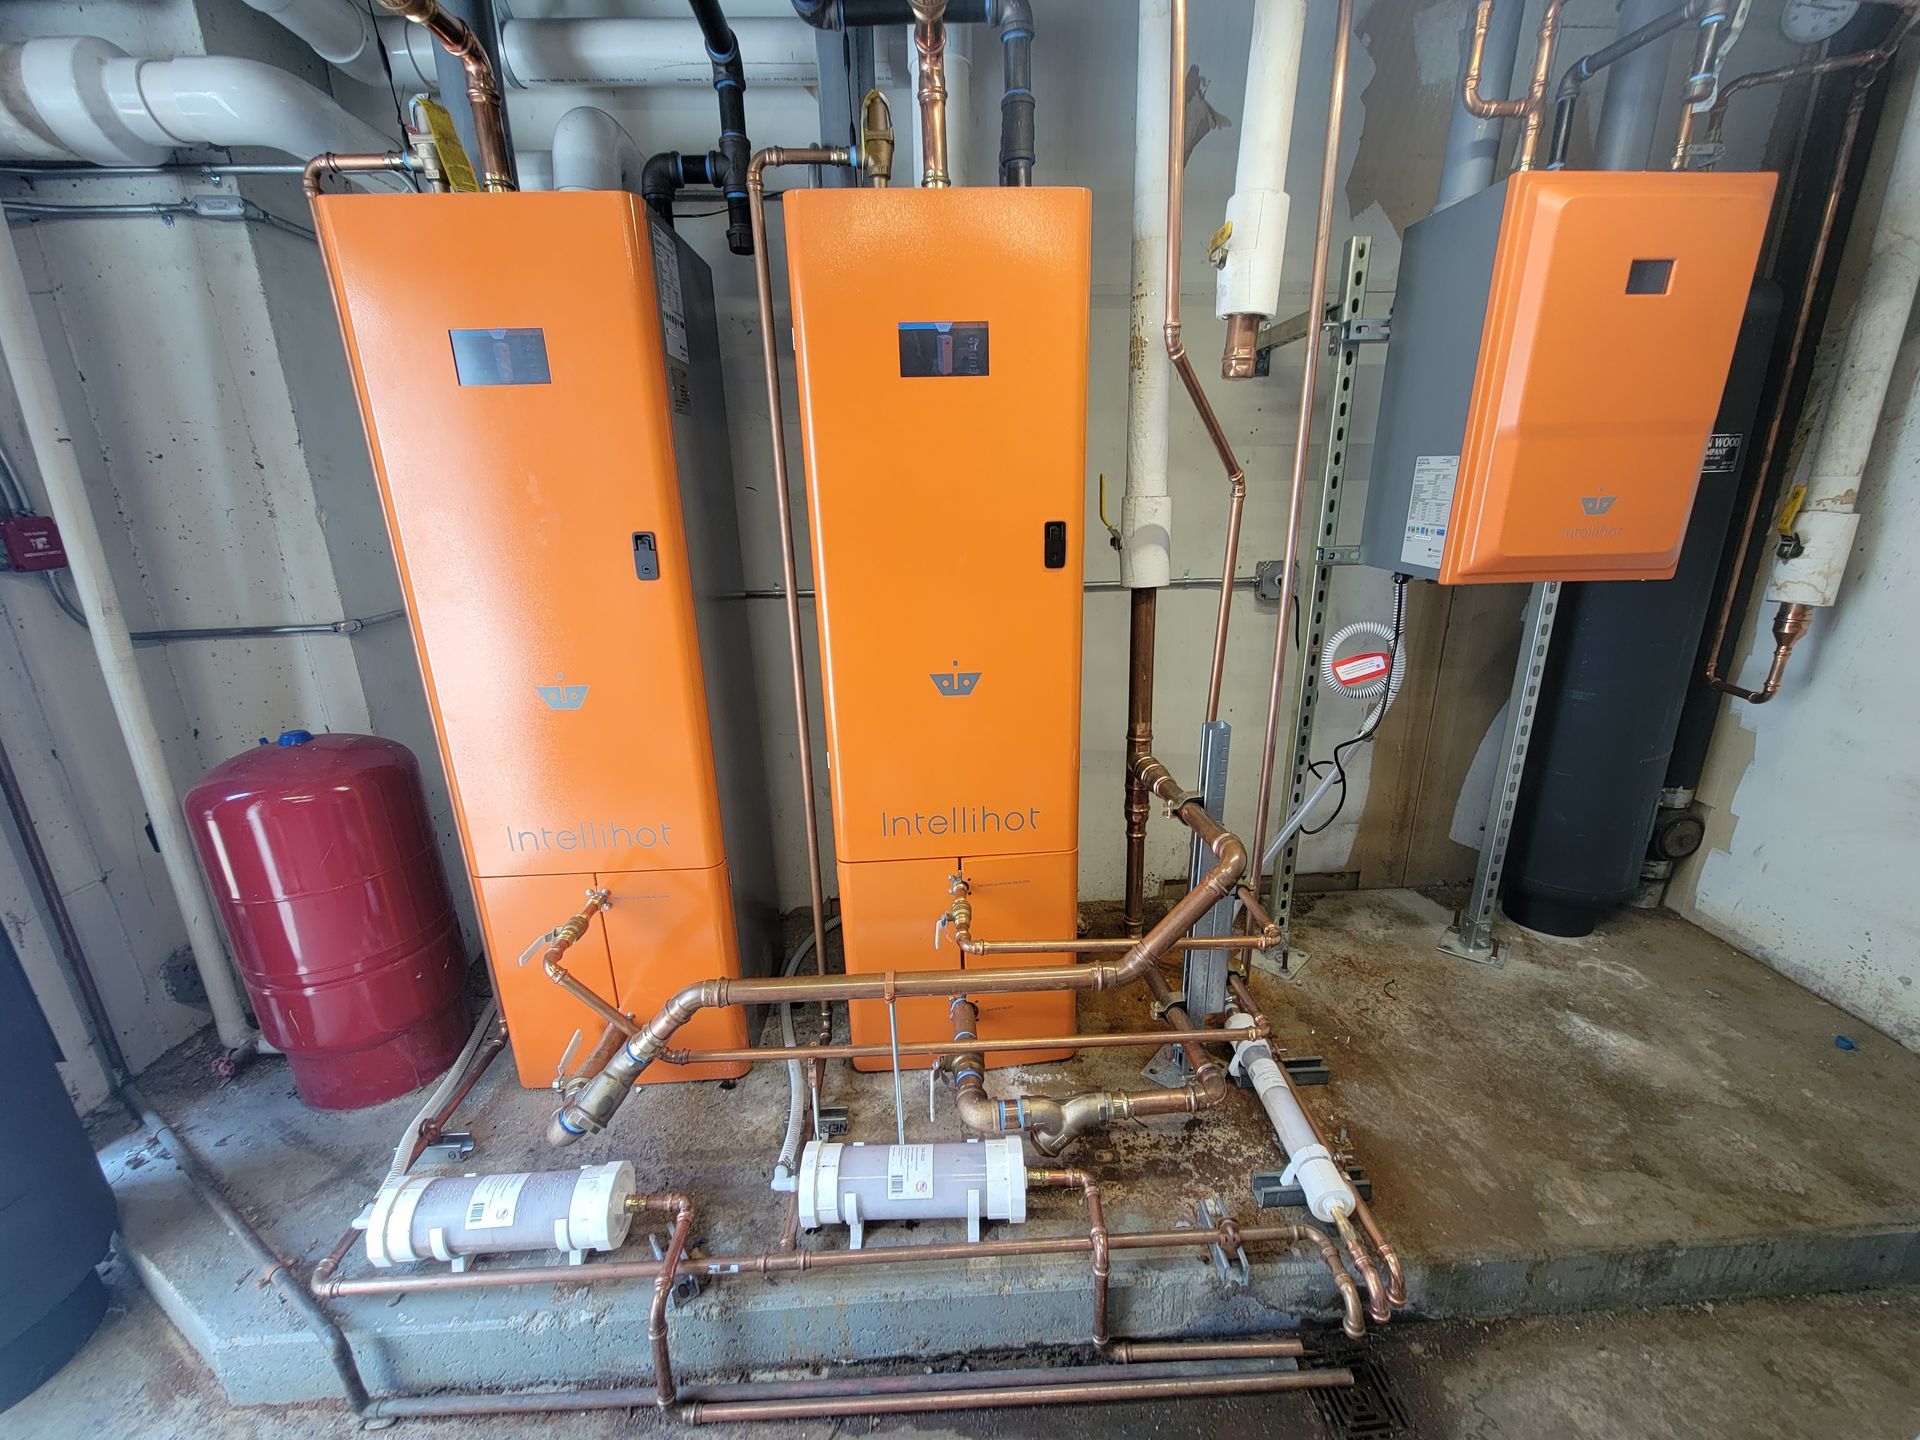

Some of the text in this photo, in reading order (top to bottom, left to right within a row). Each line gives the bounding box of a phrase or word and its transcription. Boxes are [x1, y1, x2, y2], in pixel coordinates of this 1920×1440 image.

[1715, 437, 1740, 447] WOOD
[507, 821, 672, 851] Intellihot
[883, 806, 1040, 836] Intellihot
